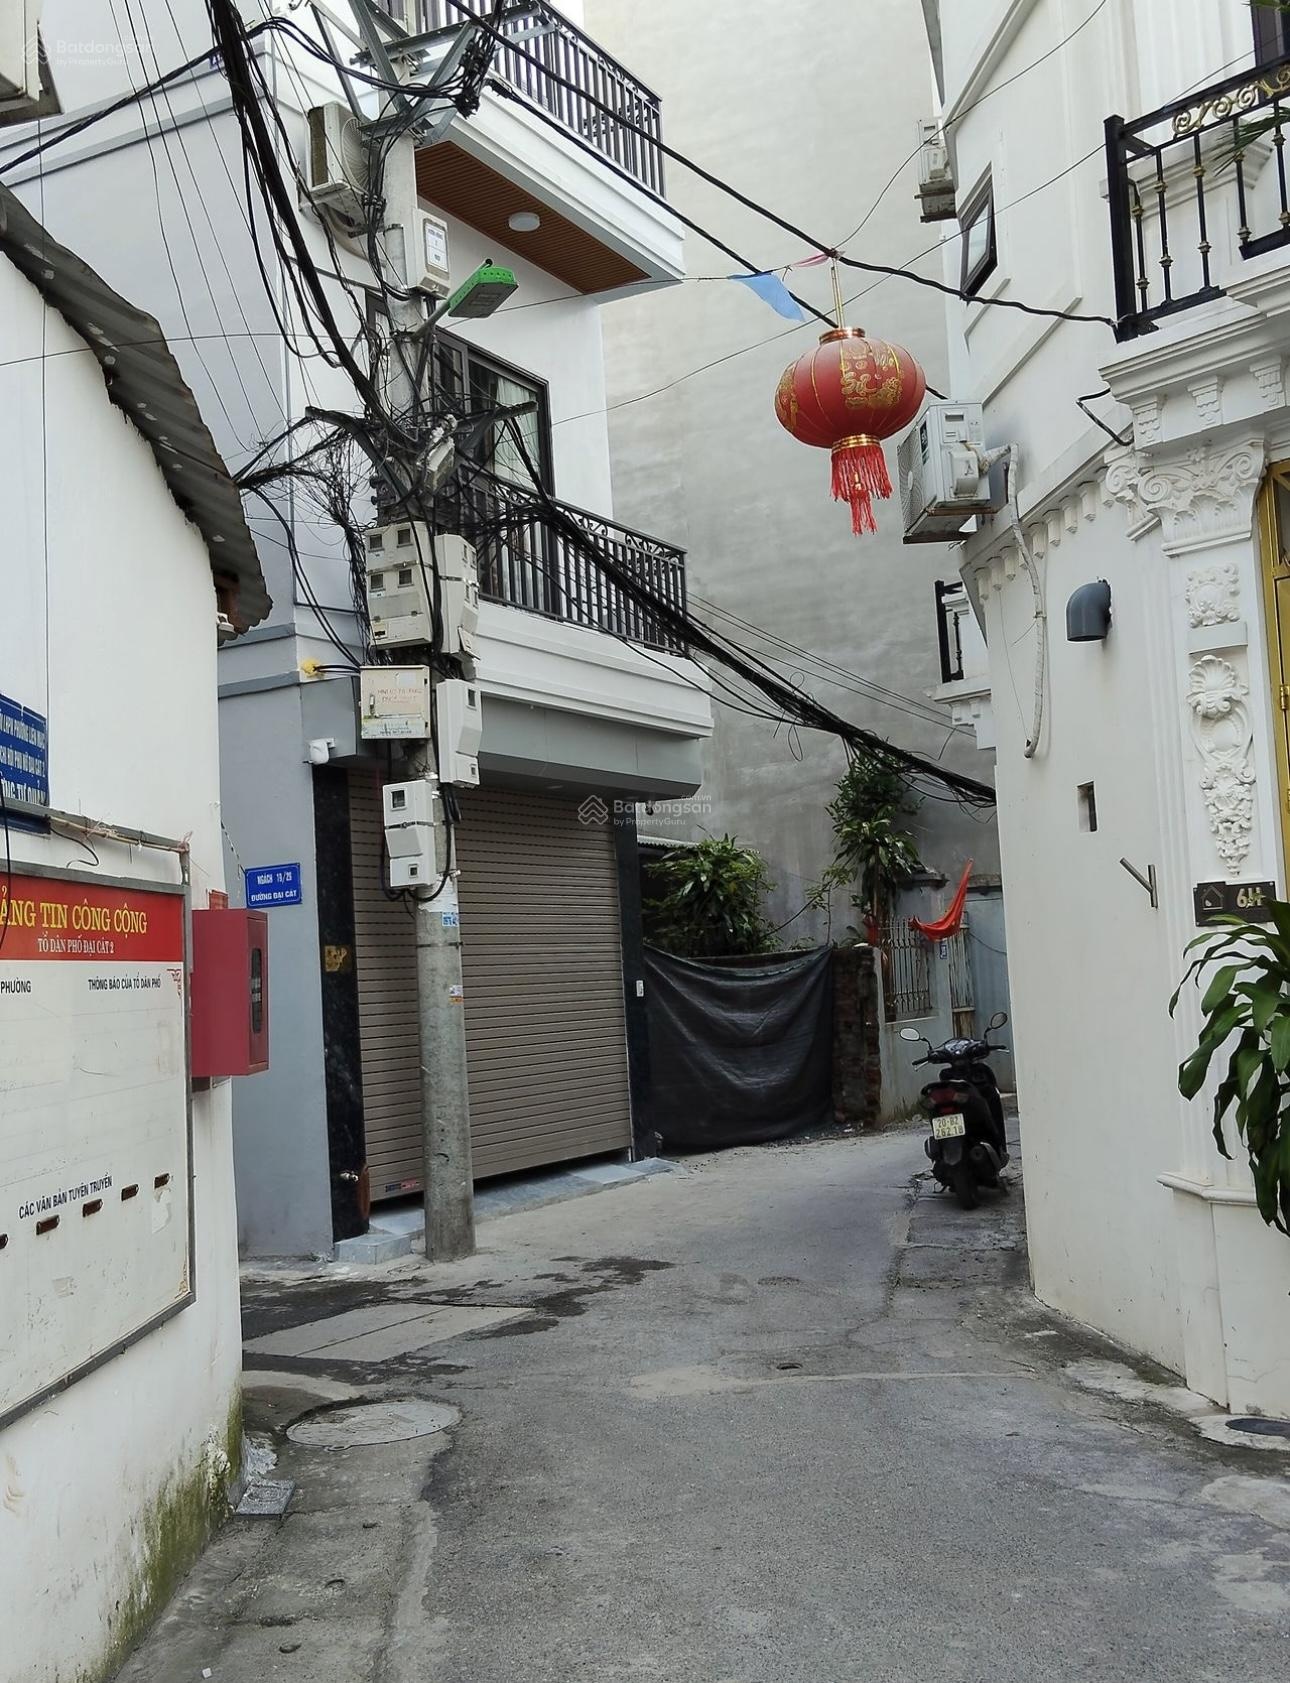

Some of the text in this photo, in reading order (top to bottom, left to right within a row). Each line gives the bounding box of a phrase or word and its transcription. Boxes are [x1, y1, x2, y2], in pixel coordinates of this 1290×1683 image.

[40, 902, 68, 929] TIN
[72, 898, 111, 932] CÔNG
[113, 902, 148, 938] CỘNG
[37, 931, 49, 953] TỔ
[50, 935, 66, 953] DÂN
[67, 934, 83, 953] PHỐ
[110, 941, 115, 954] 2
[0, 977, 32, 994] PHƯỜNG
[88, 976, 108, 991] THÔNG
[108, 976, 120, 990] BÁO
[19, 1201, 35, 1219] CÁC
[36, 1196, 52, 1213] VĂN
[52, 1188, 68, 1207] BẢN
